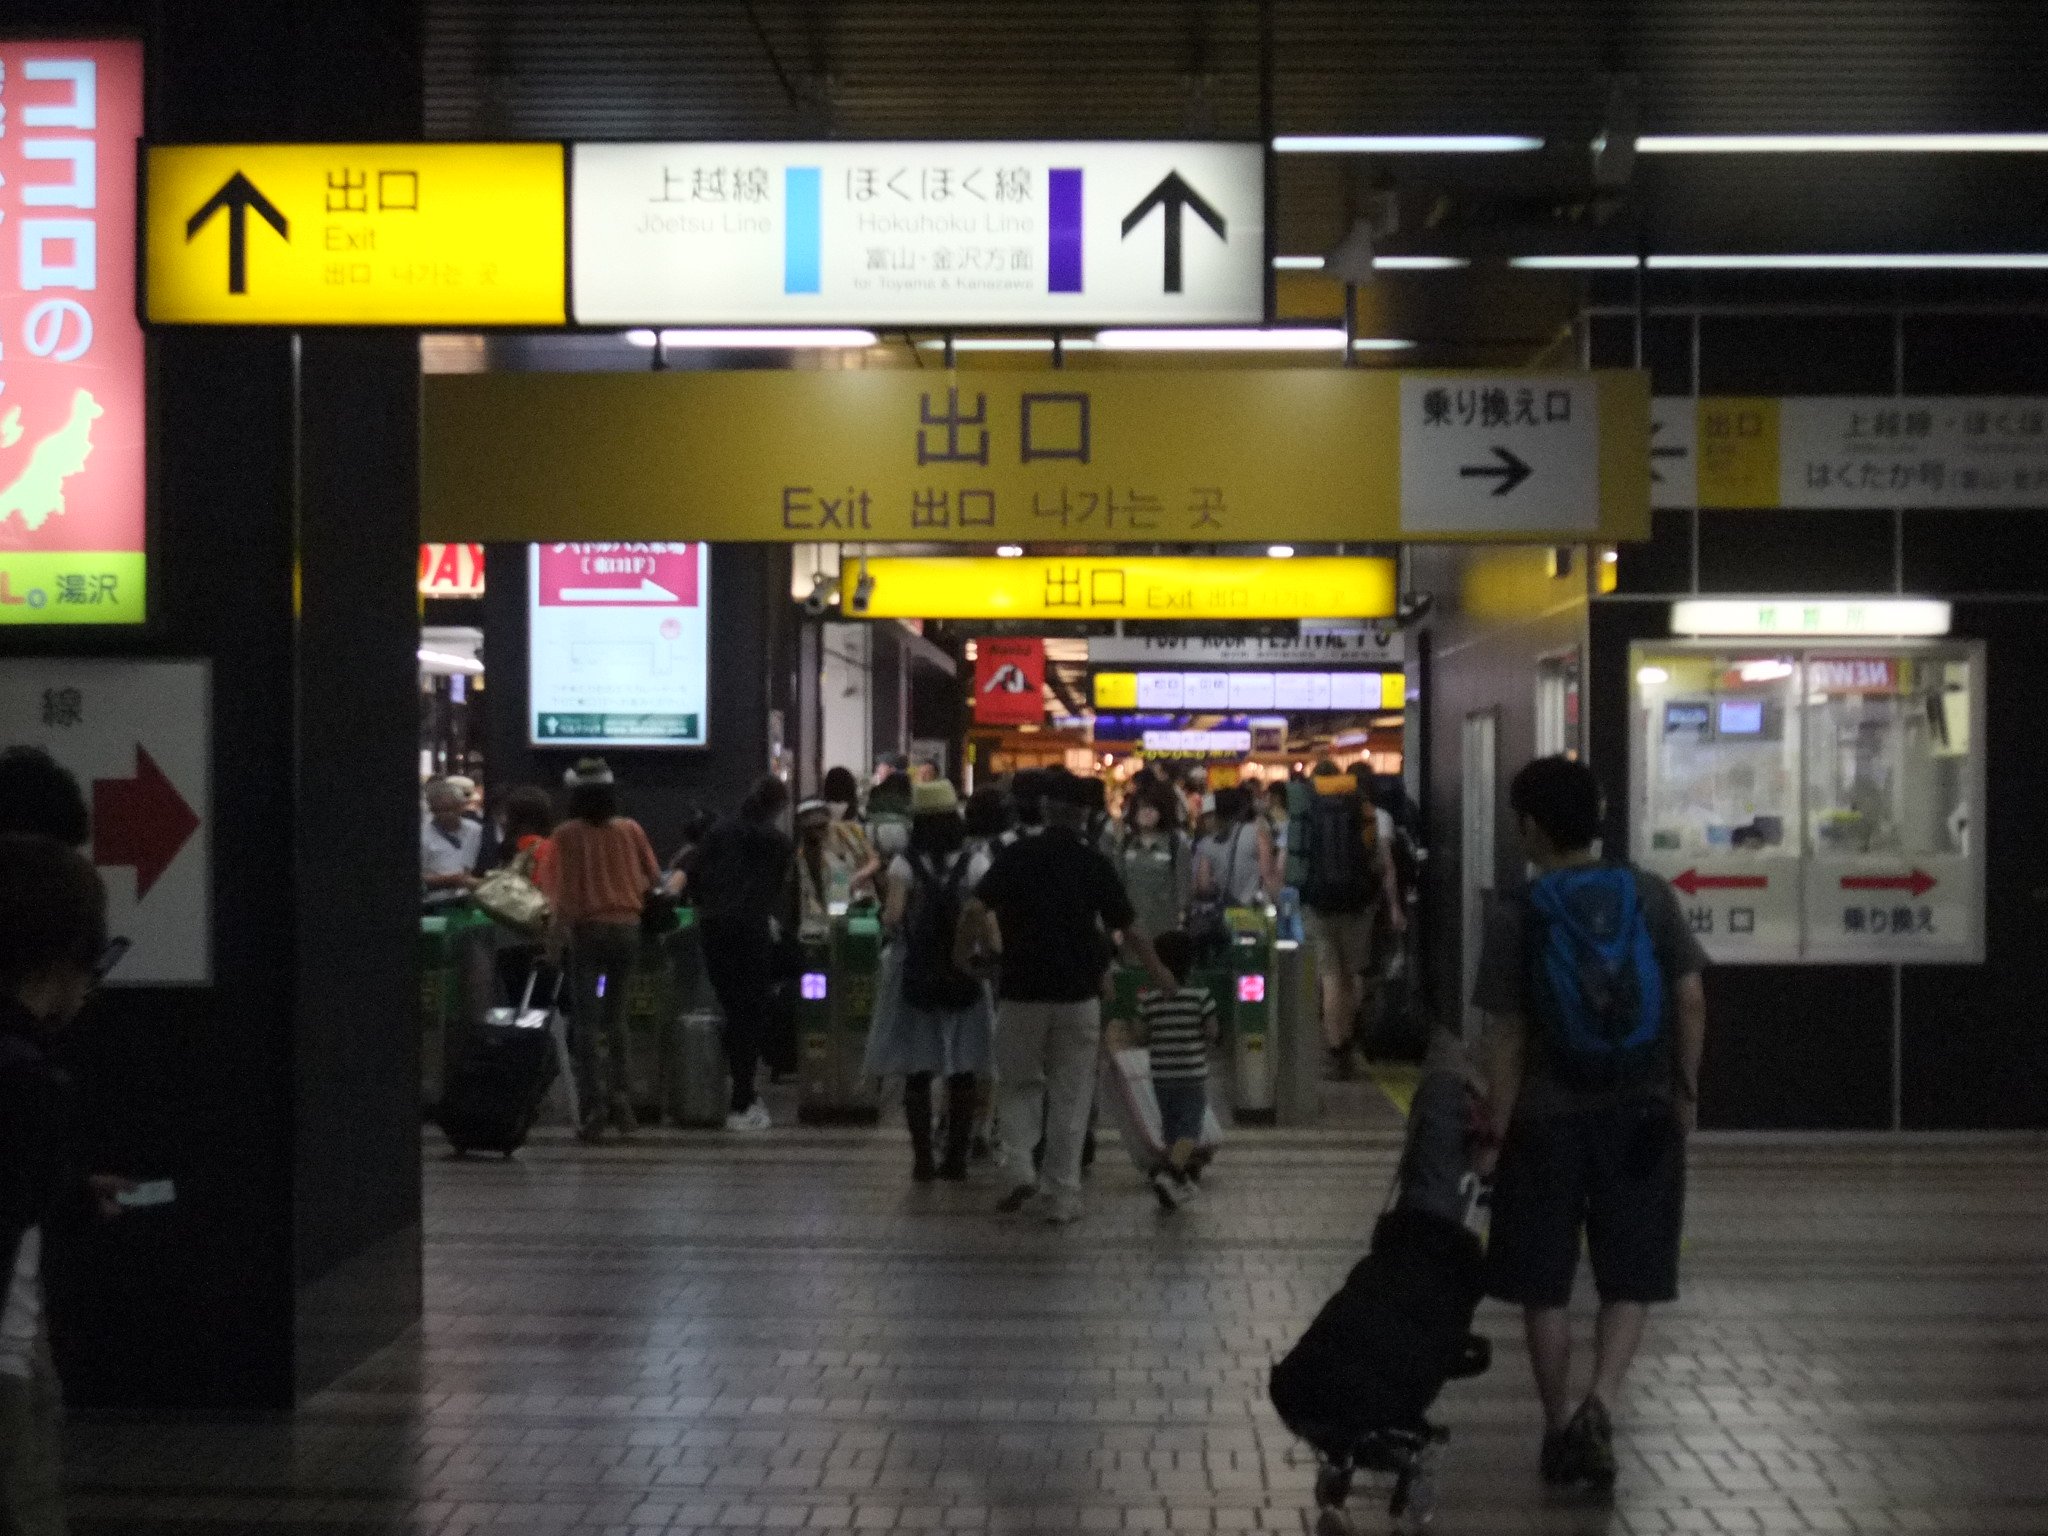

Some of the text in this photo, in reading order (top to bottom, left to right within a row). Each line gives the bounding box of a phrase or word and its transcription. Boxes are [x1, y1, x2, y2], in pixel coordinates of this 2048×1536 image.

[326, 168, 418, 212] 出口
[649, 166, 770, 203] 上越線
[847, 167, 1032, 203] ほくほく線
[22, 59, 96, 361] ココロの
[723, 213, 771, 233] Line
[859, 213, 1034, 233] Hokuhoku Line
[325, 226, 376, 251] Exit
[326, 263, 370, 285] 出口
[866, 246, 1033, 270] 富山・金沢方面
[881, 277, 936, 292] Toyama
[957, 277, 1034, 290] Kanazawa
[1423, 387, 1571, 427] 乗り換え口
[917, 387, 1090, 466] 出口
[783, 486, 1227, 529] Exit 出口 나가는 곳
[56, 573, 119, 604] 湯沢
[1045, 565, 1125, 607] 出口
[1146, 585, 1194, 609] Exit
[1208, 586, 1249, 609] 出口
[41, 686, 83, 727] 線
[1688, 906, 1755, 933] 出口
[1843, 904, 1936, 933] 乗り換え
